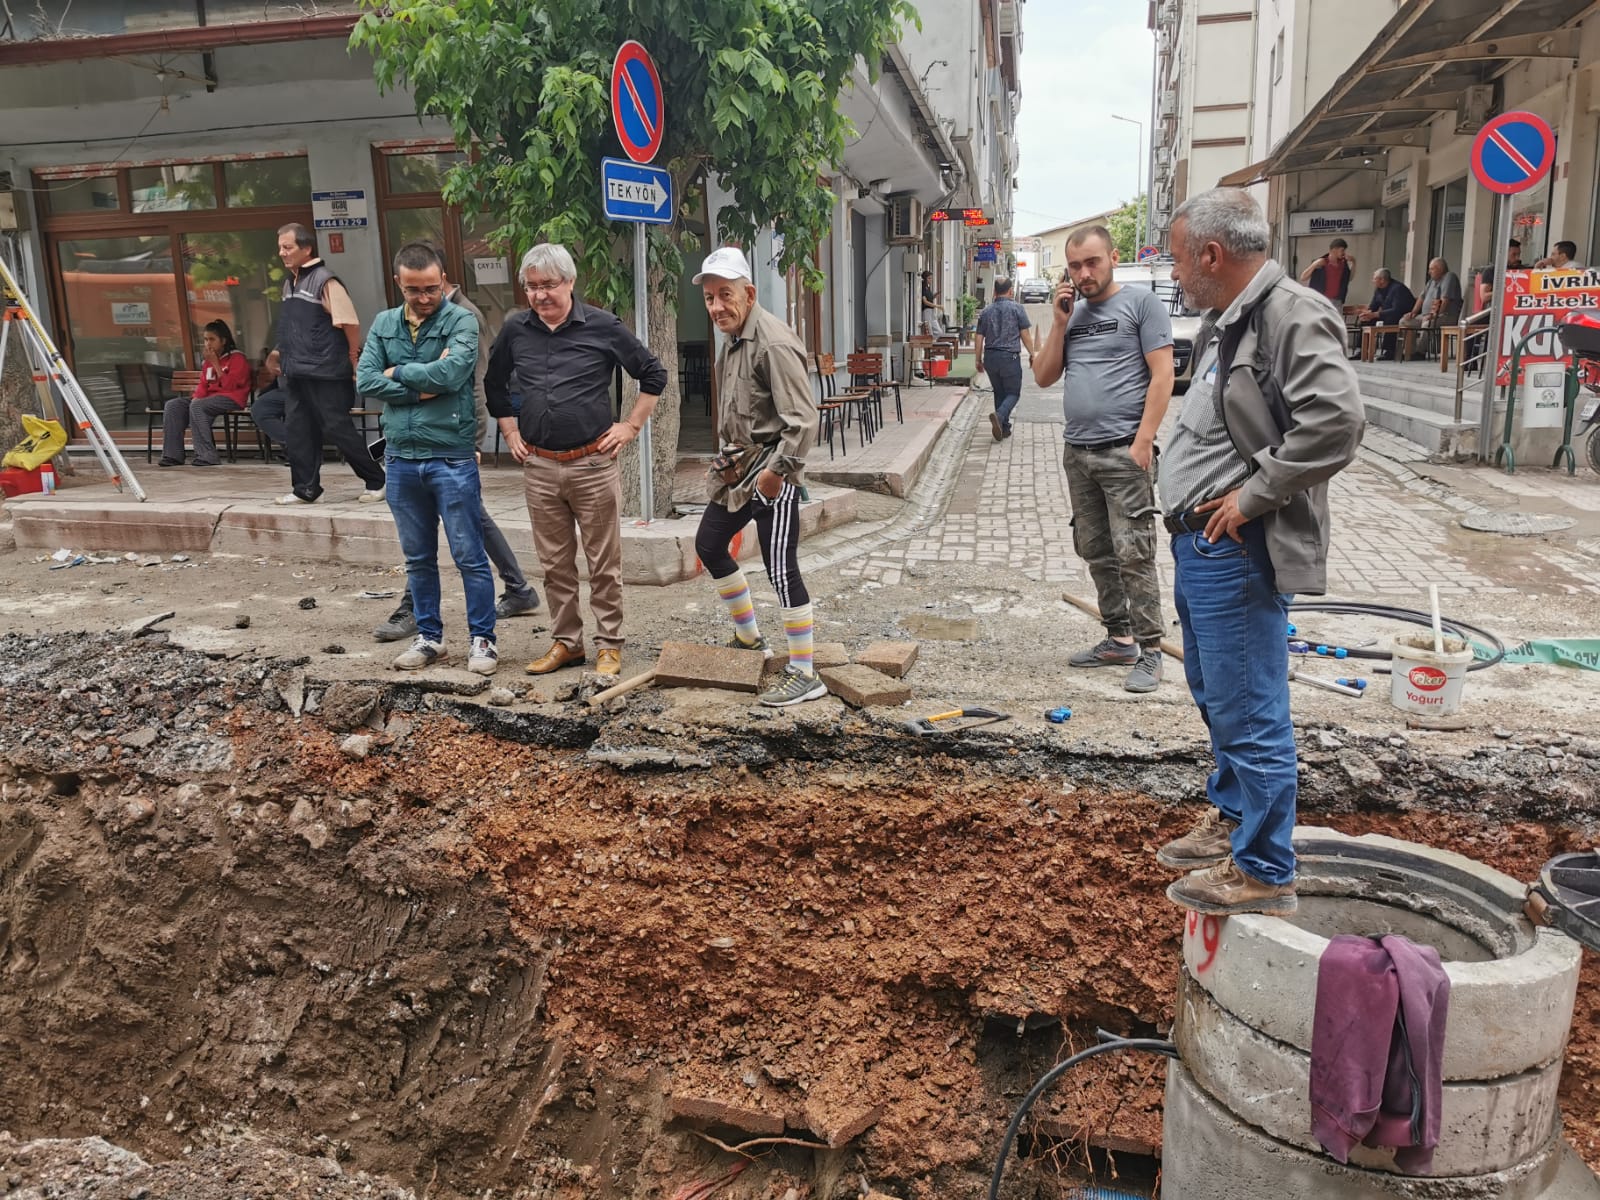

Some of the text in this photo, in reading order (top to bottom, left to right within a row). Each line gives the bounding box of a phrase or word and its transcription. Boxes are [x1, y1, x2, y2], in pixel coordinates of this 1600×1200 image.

[609, 182, 656, 202] TEK YÖN
[1310, 217, 1354, 228] Milangaz
[1514, 293, 1597, 309] Erkek
